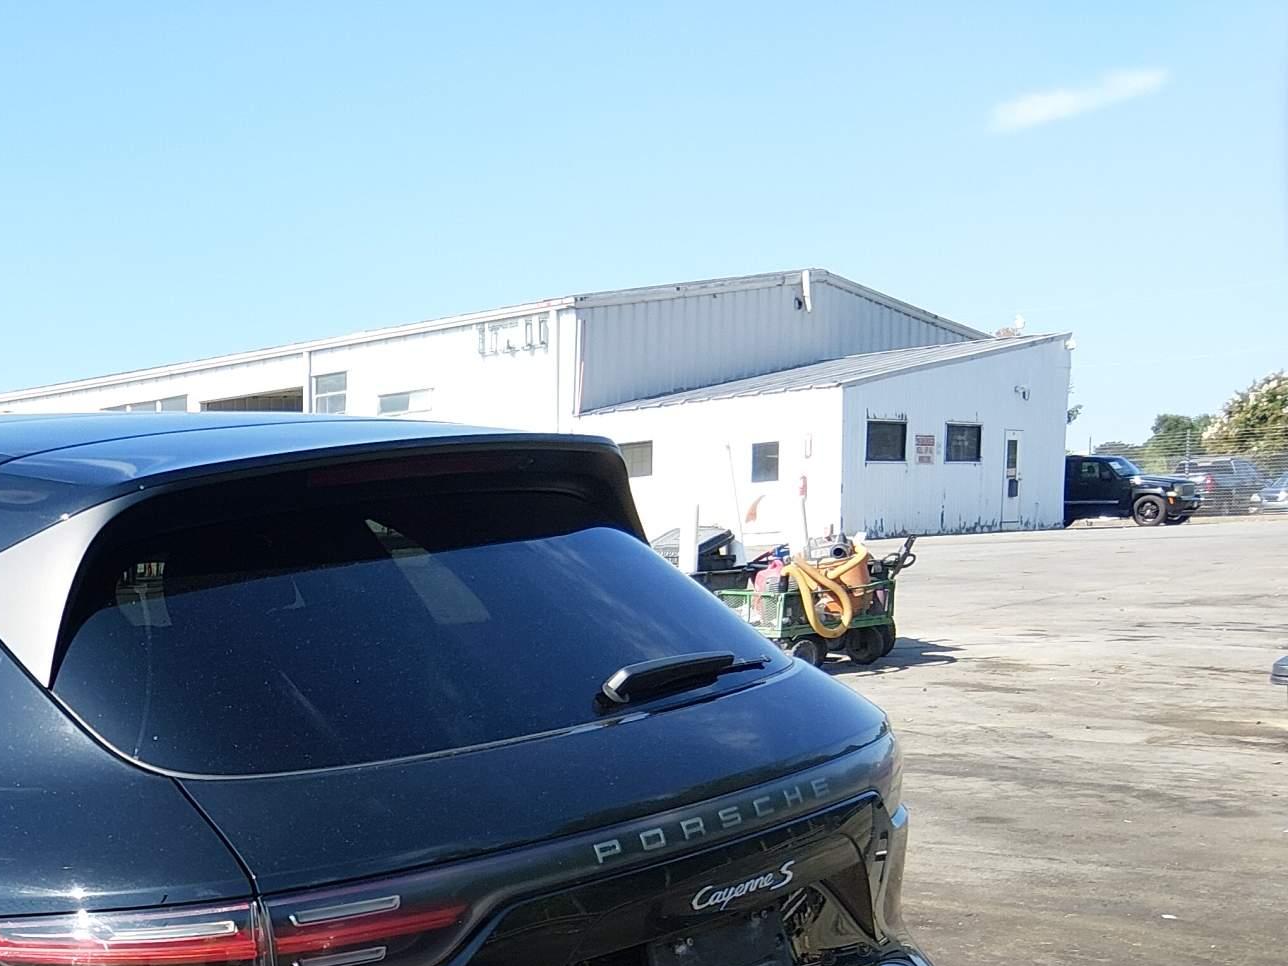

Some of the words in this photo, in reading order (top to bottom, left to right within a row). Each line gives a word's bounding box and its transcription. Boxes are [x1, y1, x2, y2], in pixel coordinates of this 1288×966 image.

[593, 777, 831, 864] PORSCHE
[691, 872, 774, 911] Cayenne
[769, 859, 796, 891] S
